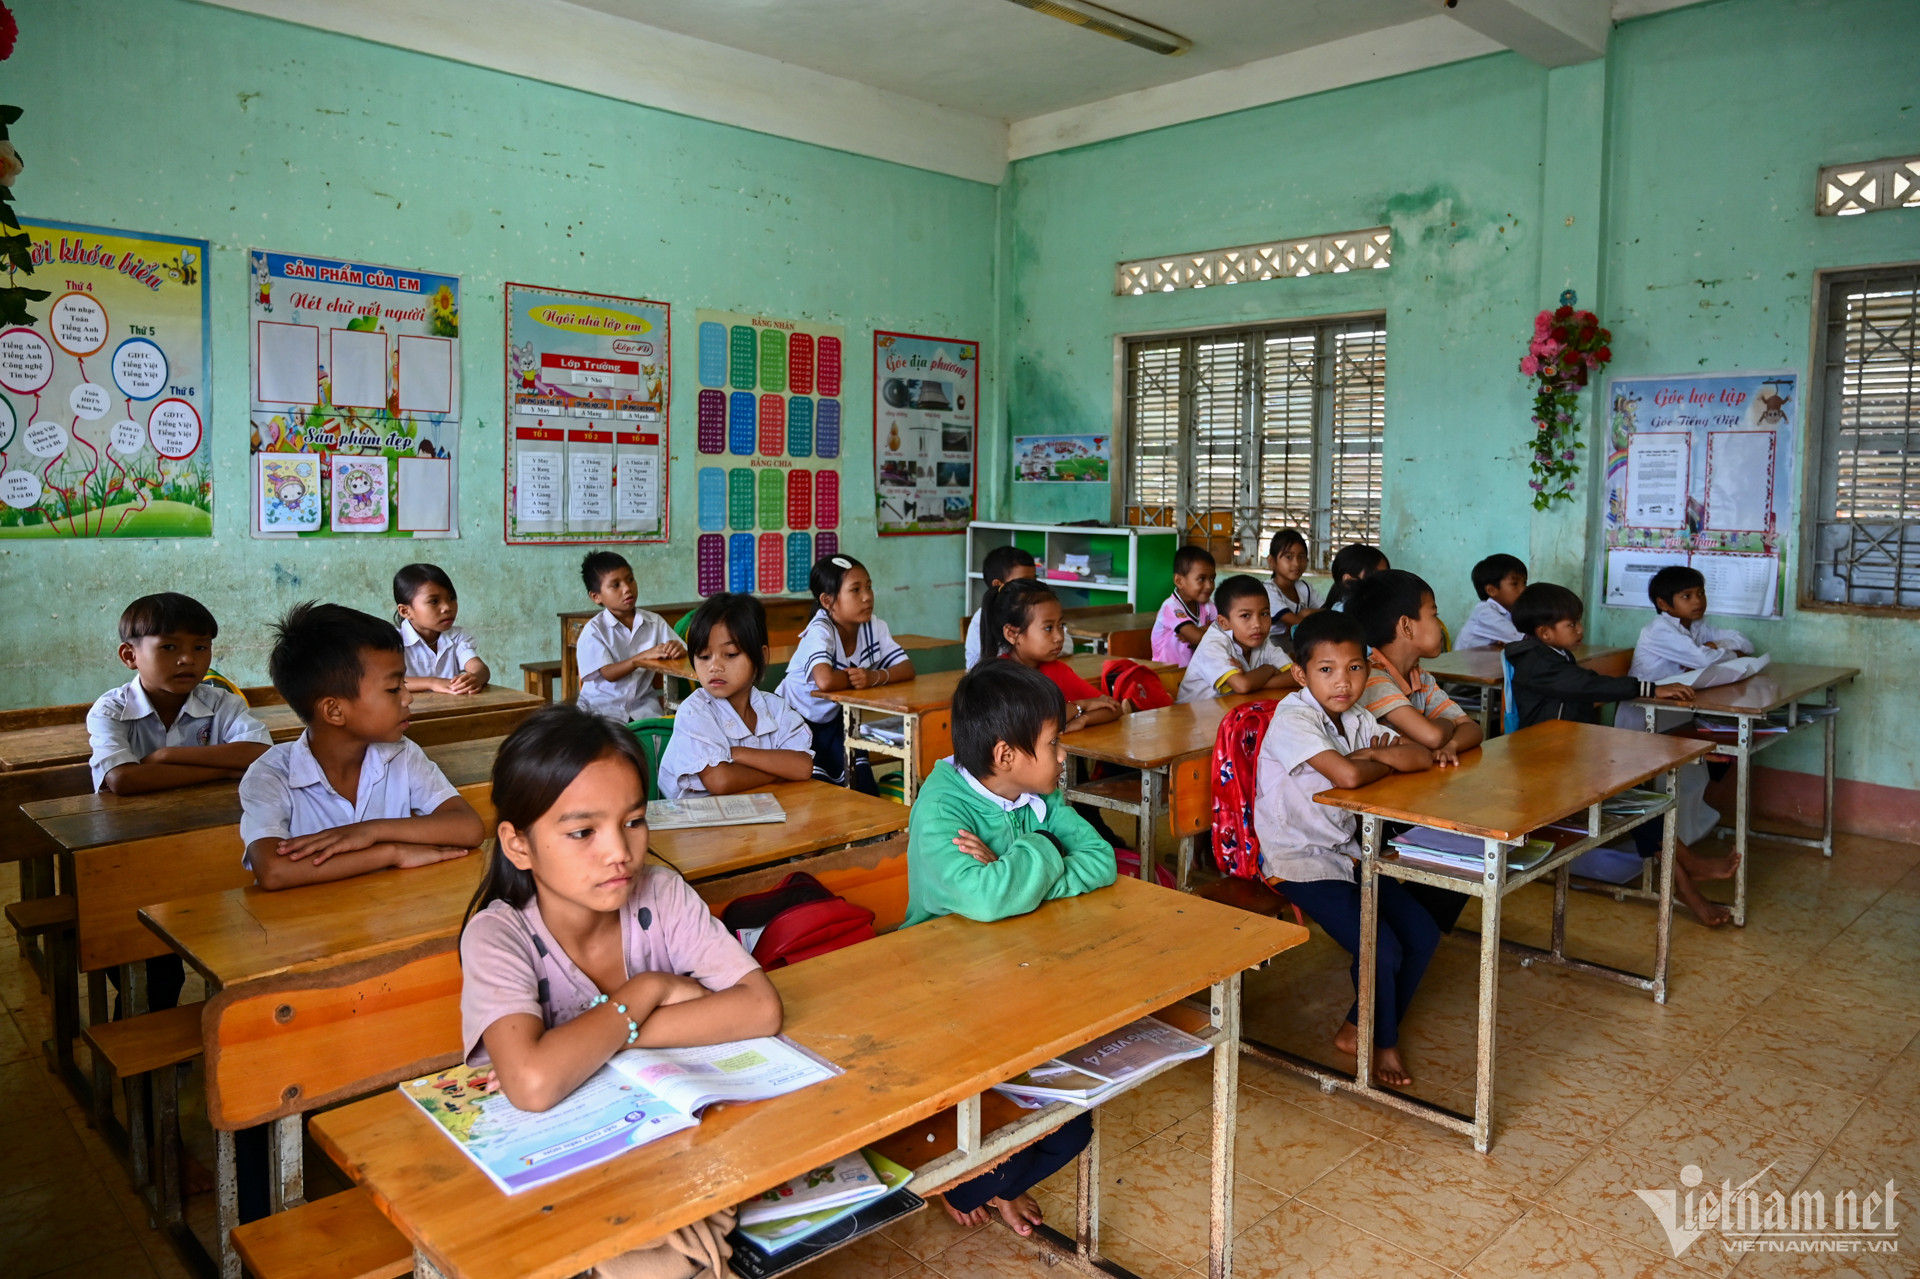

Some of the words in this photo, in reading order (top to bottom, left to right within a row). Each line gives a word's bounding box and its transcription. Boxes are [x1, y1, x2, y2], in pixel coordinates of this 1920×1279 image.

[59, 237, 115, 270] khóa
[118, 251, 165, 292] biểu
[284, 260, 316, 278] SẢN
[320, 264, 363, 285] PHẨM
[366, 271, 395, 288] CỦA
[399, 278, 421, 291] EM
[65, 280, 85, 291] Thứ
[86, 283, 93, 292] 4
[290, 291, 322, 311] Nét
[326, 298, 355, 314] chữ
[358, 301, 382, 316] nết
[385, 308, 426, 322] người
[543, 309, 575, 324] Ngôi
[578, 315, 600, 327] nhà
[604, 317, 622, 331] lớp
[625, 323, 642, 332] em
[752, 317, 772, 327] BẢNG
[774, 321, 795, 330] NHÂN
[129, 325, 149, 336] Thứ
[150, 326, 156, 336] 5
[561, 358, 581, 369] Lớp
[584, 361, 622, 373] Trưởng
[886, 353, 907, 373] Góc
[910, 354, 928, 371] địa
[930, 356, 968, 380] phương
[170, 386, 187, 396] Thứ
[189, 388, 195, 396] 6
[1654, 387, 1685, 408] Góc
[1688, 387, 1716, 408] học
[1720, 387, 1747, 407] tập
[1651, 416, 1673, 428] Góc
[1677, 414, 1710, 428] Tiếng
[1713, 414, 1740, 428] Việt
[304, 427, 336, 445] Sản
[339, 429, 382, 447] phẩm
[386, 433, 414, 449] đẹp
[533, 429, 543, 438] TỔ
[584, 431, 593, 440] TỔ
[632, 433, 641, 442] TỔ
[751, 458, 772, 467] BẢNG
[773, 460, 793, 468] CHIA
[1097, 1039, 1132, 1057] VIỆT
[1082, 1055, 1100, 1065] 4
